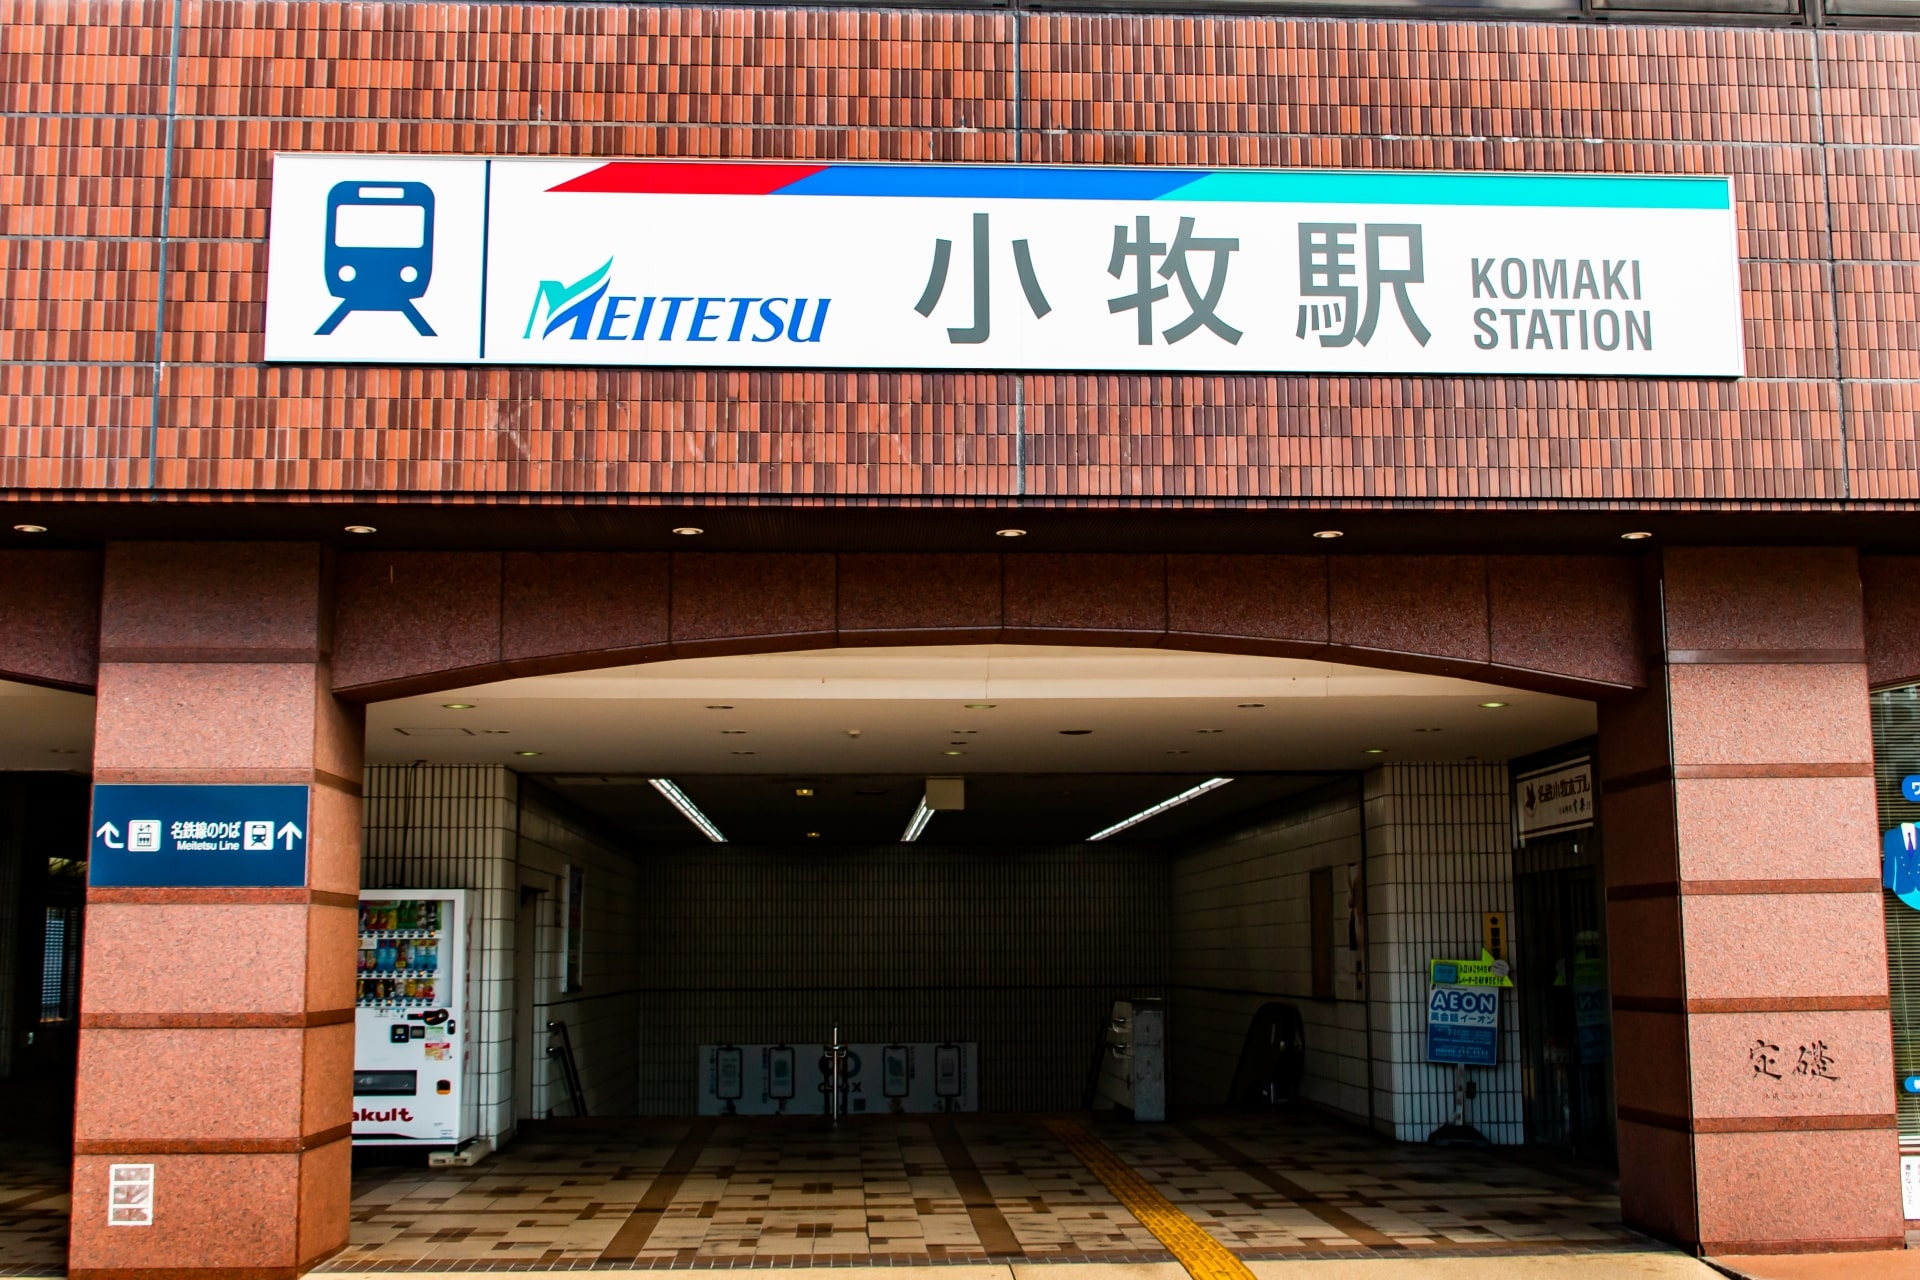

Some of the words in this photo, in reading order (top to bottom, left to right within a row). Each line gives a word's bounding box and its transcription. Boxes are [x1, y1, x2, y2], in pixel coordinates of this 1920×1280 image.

[523, 256, 832, 343] MEITETSU
[914, 213, 1431, 347] 小牧駅
[1471, 258, 1641, 300] KOMAKI
[1473, 307, 1653, 351] STATION
[170, 821, 241, 839] 名鉄線のりば
[176, 840, 217, 851] Meitetsu
[218, 840, 240, 851] Line
[1432, 991, 1496, 1014] AEON
[1749, 1040, 1840, 1081] 定礎
